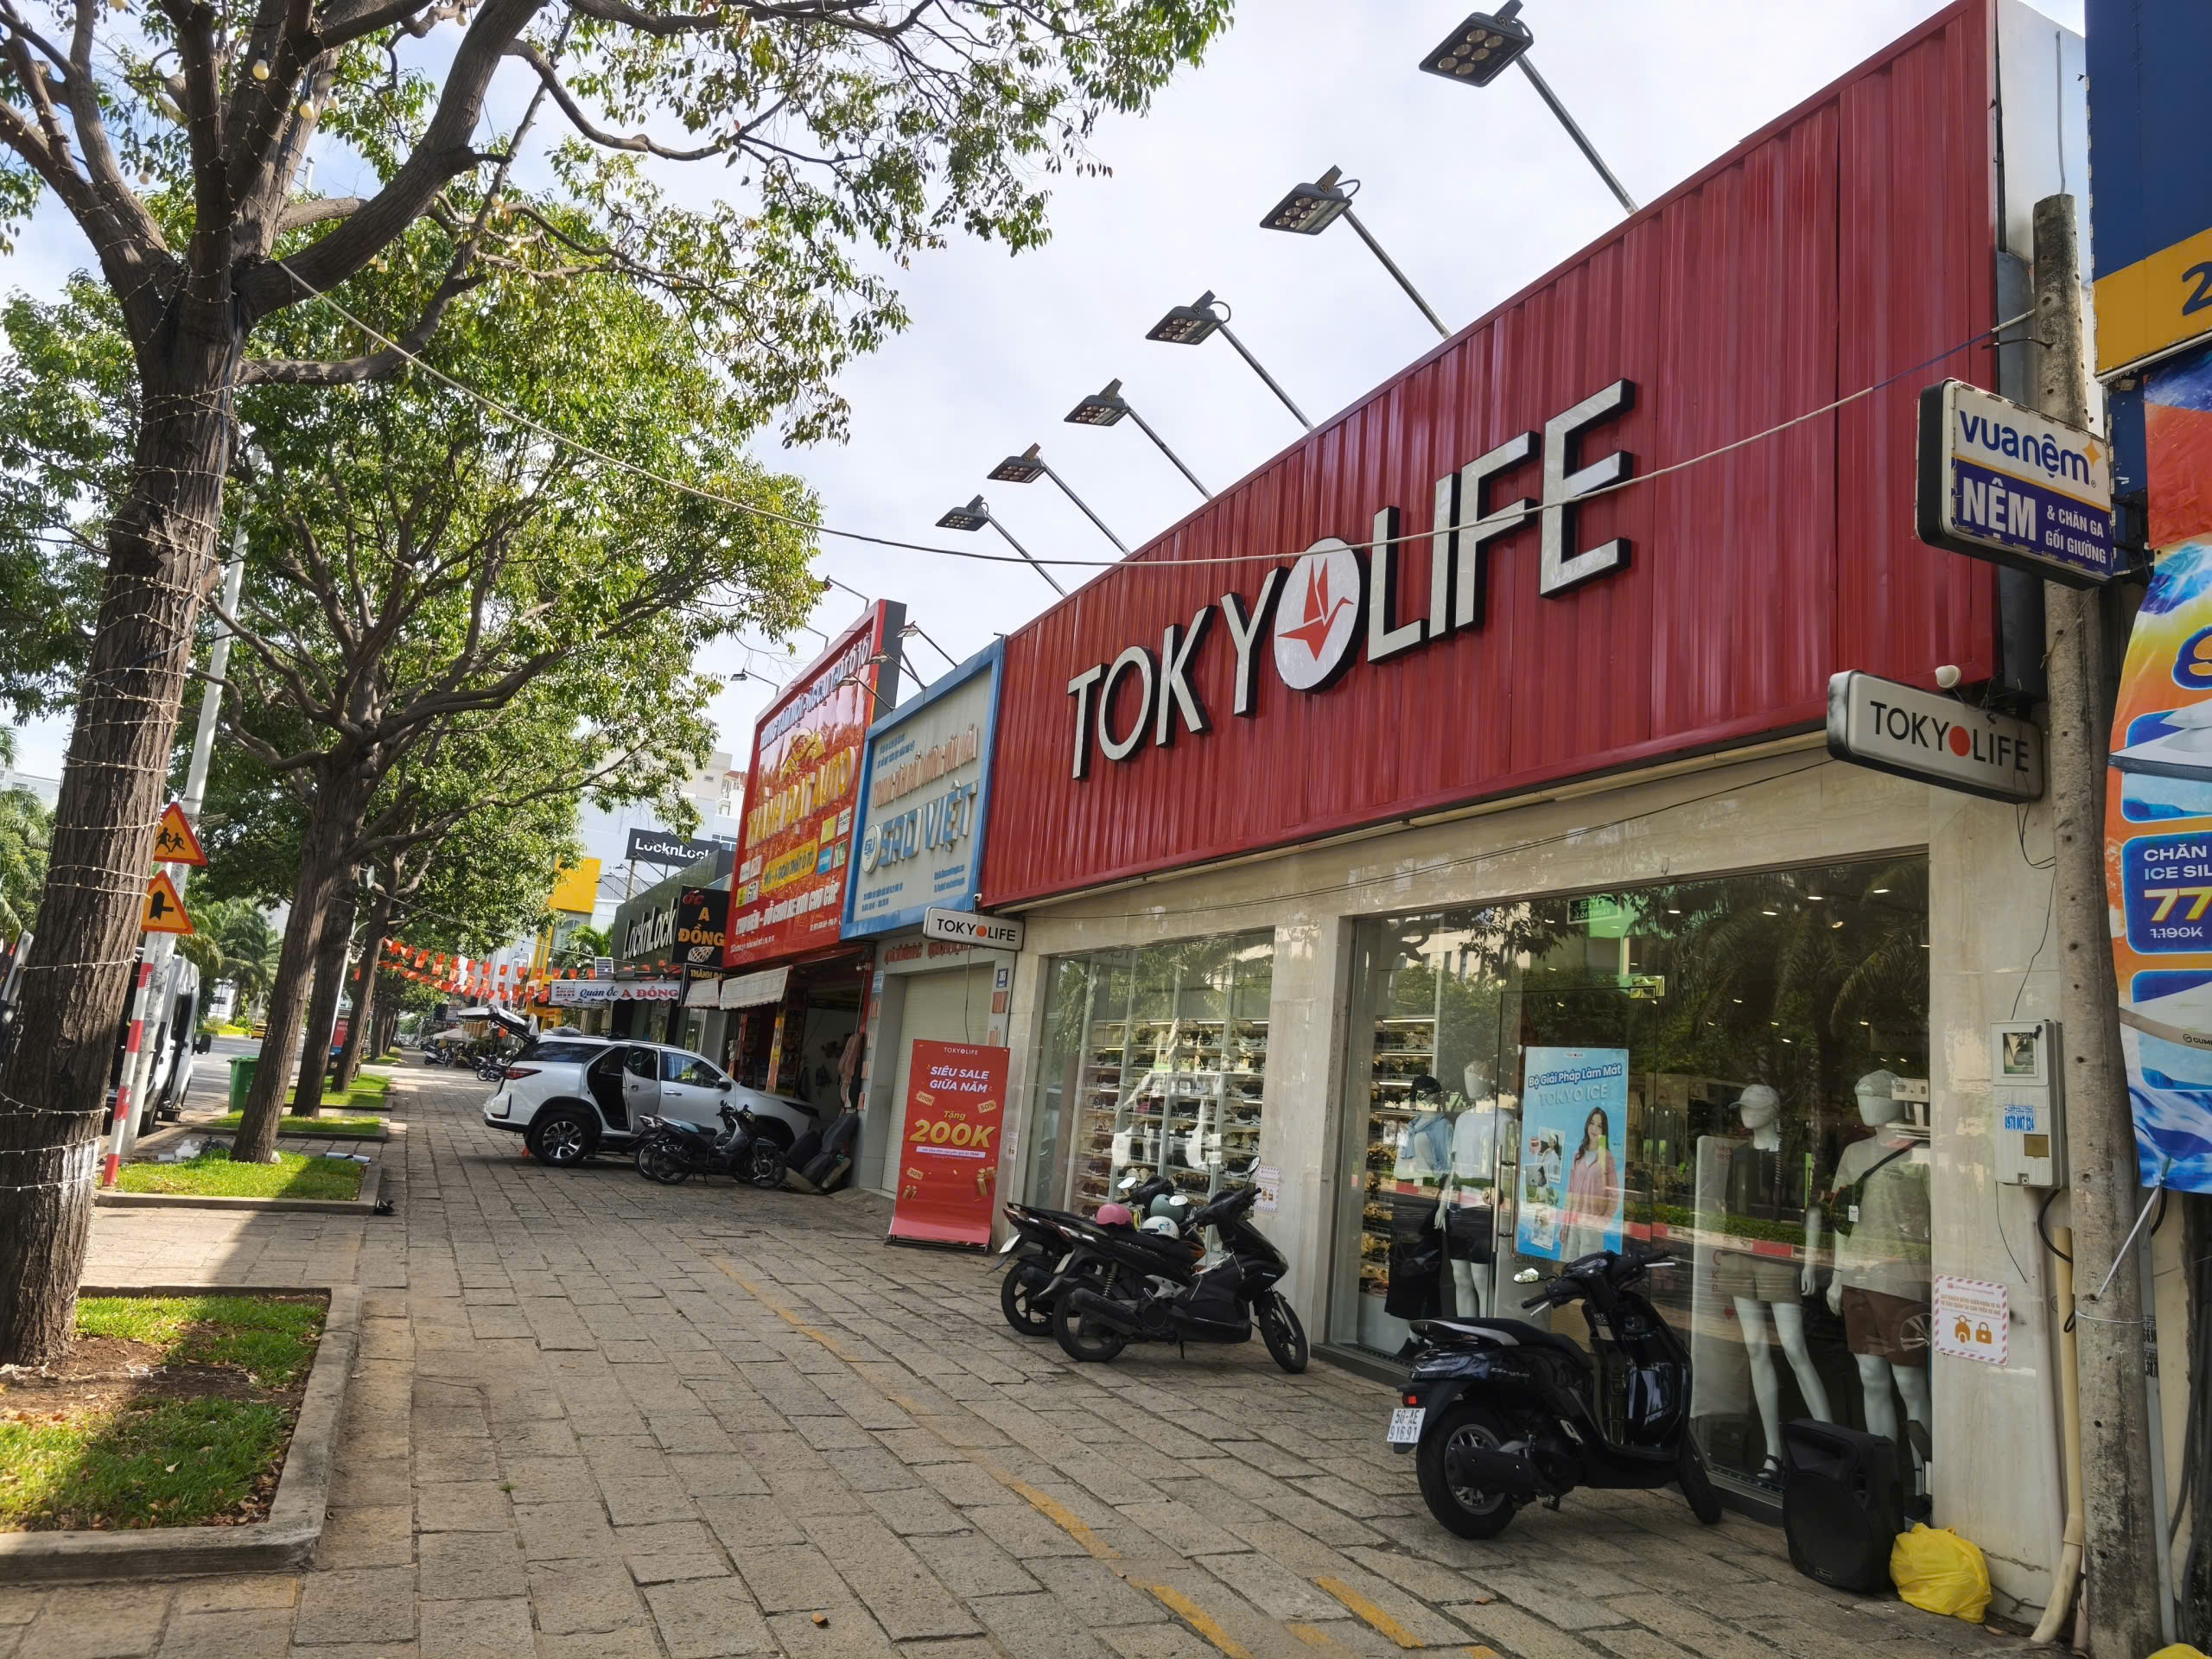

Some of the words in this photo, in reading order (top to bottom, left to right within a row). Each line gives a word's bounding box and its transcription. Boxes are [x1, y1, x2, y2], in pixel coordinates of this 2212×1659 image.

[1962, 477, 2037, 542] NỆM
[2047, 505, 2056, 521] &
[2058, 508, 2088, 533] CHĂN
[2090, 520, 2104, 538] GA
[2045, 528, 2064, 550] GỐI
[2067, 538, 2107, 564] GIƯỜNG
[878, 808, 924, 868] SAO
[925, 779, 978, 853] VIỆT
[2144, 843, 2207, 861] CHĂN
[2145, 866, 2178, 880] ICE
[698, 906, 710, 922] A
[622, 897, 677, 961] LocknLock
[677, 923, 726, 947] ĐỒNG
[2150, 926, 2203, 938] 1.190K
[580, 988, 604, 999] Quán
[606, 986, 619, 997] Ốc
[621, 988, 632, 998] A
[636, 985, 678, 998] ĐỒNG
[930, 1065, 957, 1077] SIÊU
[958, 1069, 989, 1079] SALE
[1529, 1075, 1540, 1089] Bộ
[1541, 1071, 1557, 1085] Giải
[1558, 1069, 1581, 1084] Pháp
[1582, 1066, 1602, 1080] Làm
[1603, 1063, 1622, 1077] Mát
[929, 1079, 957, 1090] GIỮA
[960, 1081, 988, 1093] NĂM
[1539, 1087, 1583, 1106] TOKYO
[1586, 1084, 1609, 1100] ICE
[944, 1110, 966, 1121] Tặng
[909, 1119, 996, 1148] 200K
[1389, 1426, 1418, 1441] 916.91
